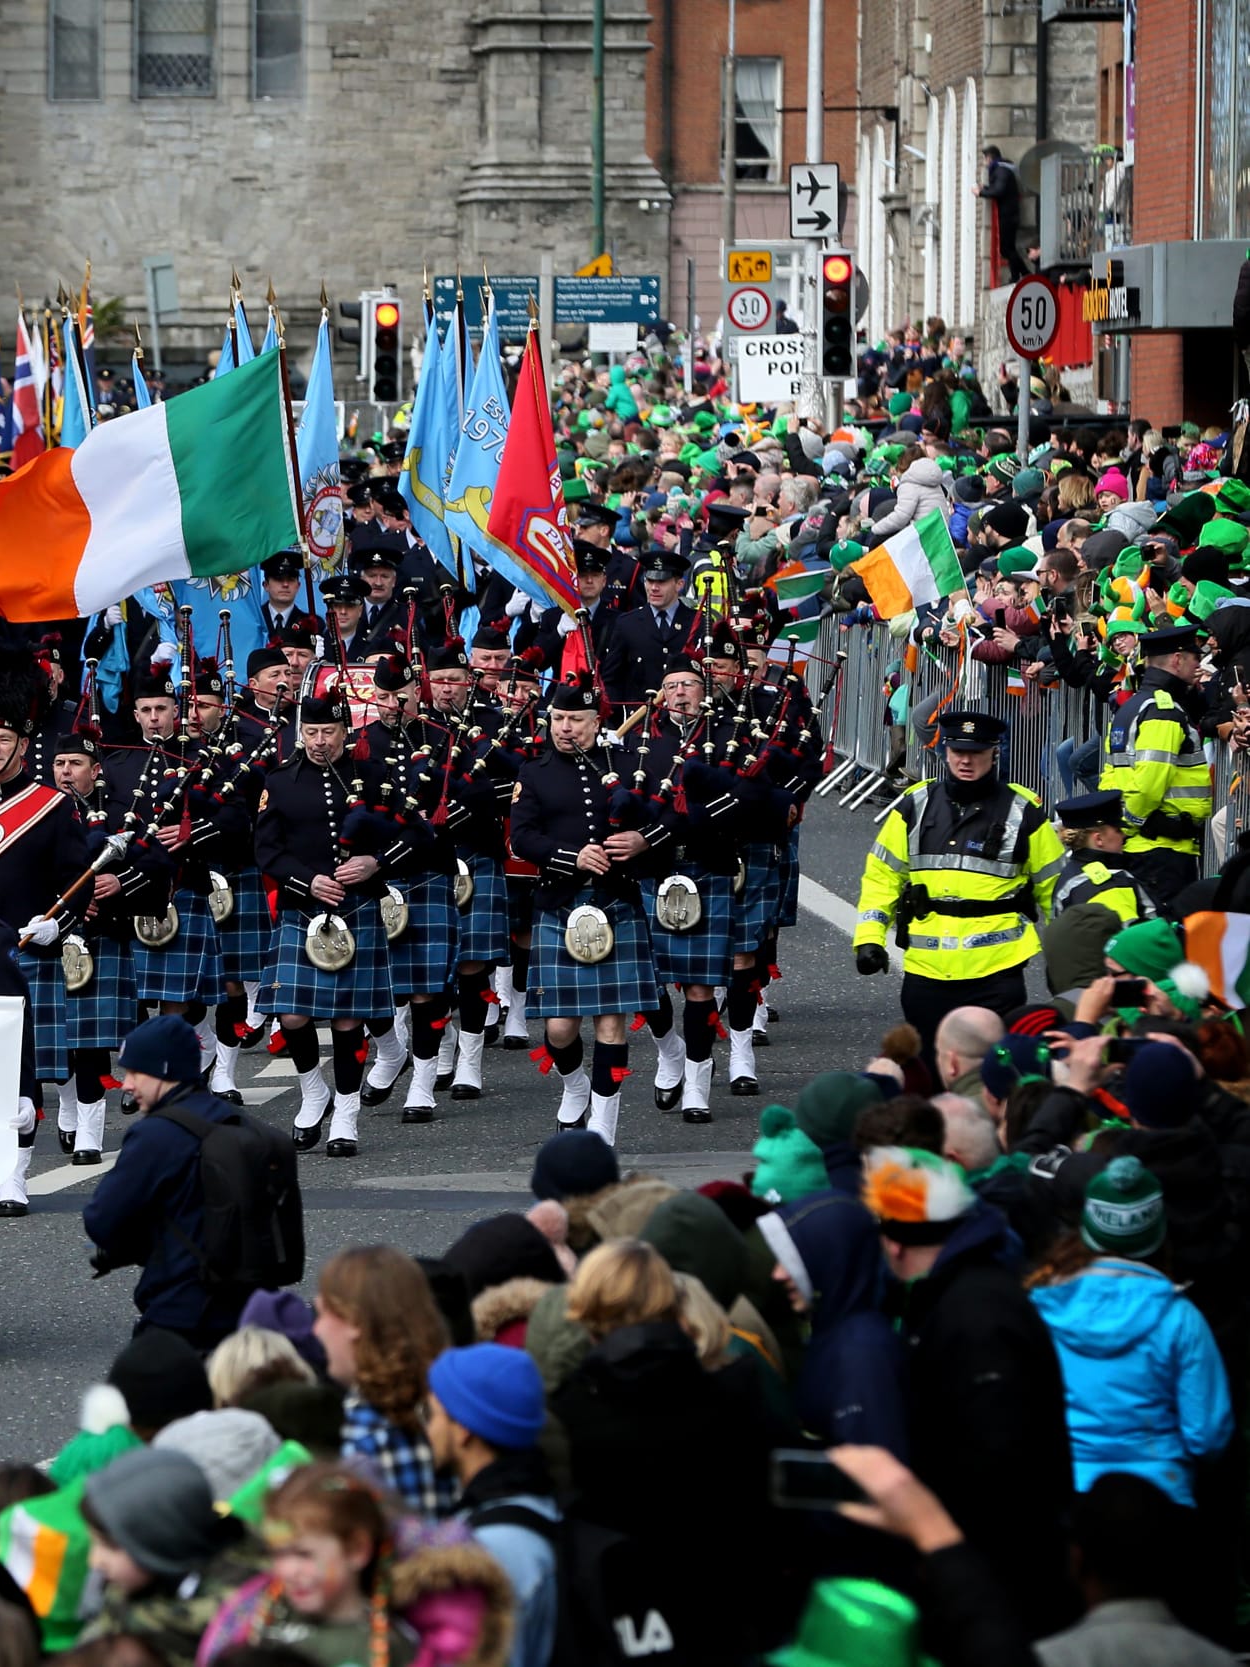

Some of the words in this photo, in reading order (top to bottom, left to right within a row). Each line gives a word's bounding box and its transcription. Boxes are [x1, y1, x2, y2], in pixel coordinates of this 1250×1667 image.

[739, 297, 760, 316] 30
[1109, 287, 1129, 319] HOTEL
[1021, 296, 1046, 330] 50
[1022, 335, 1043, 346] km/h
[971, 932, 1009, 946] GARDA
